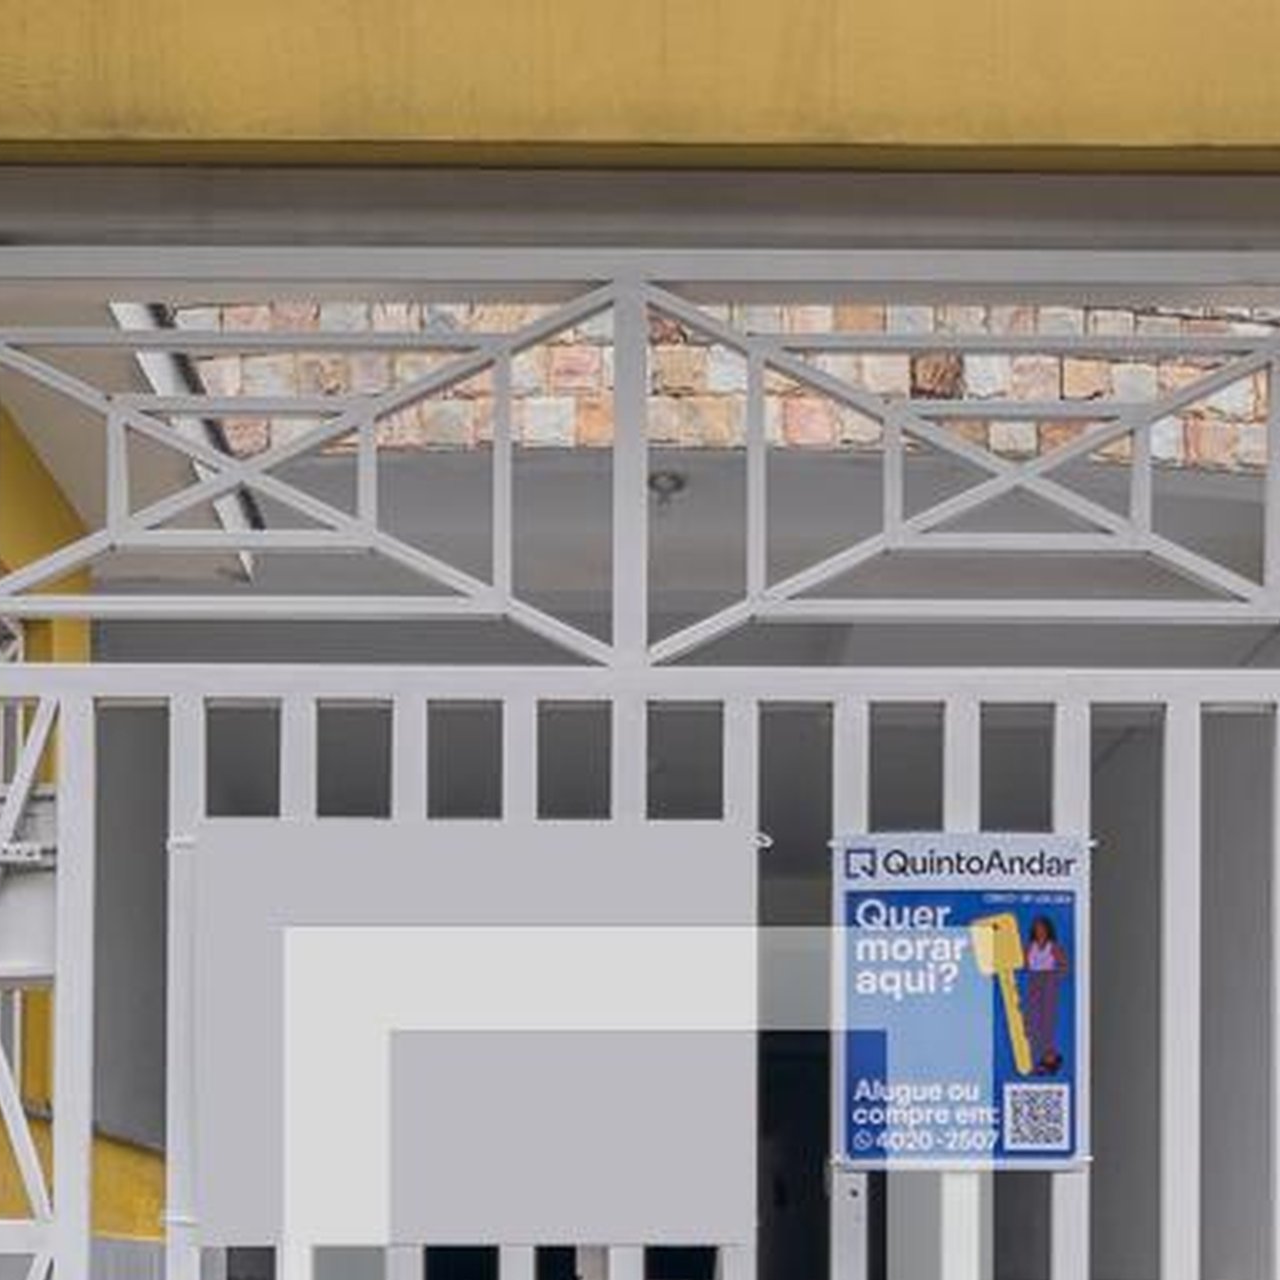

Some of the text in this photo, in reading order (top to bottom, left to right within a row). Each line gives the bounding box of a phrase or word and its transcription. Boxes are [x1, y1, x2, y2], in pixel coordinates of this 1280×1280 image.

[882, 848, 1076, 878] QuintoAndar
[856, 898, 951, 930] Quer
[855, 936, 968, 962] morar
[855, 963, 959, 1000] aqui?
[854, 1079, 979, 1105] Alugue ou
[852, 1107, 1000, 1129] compre em:
